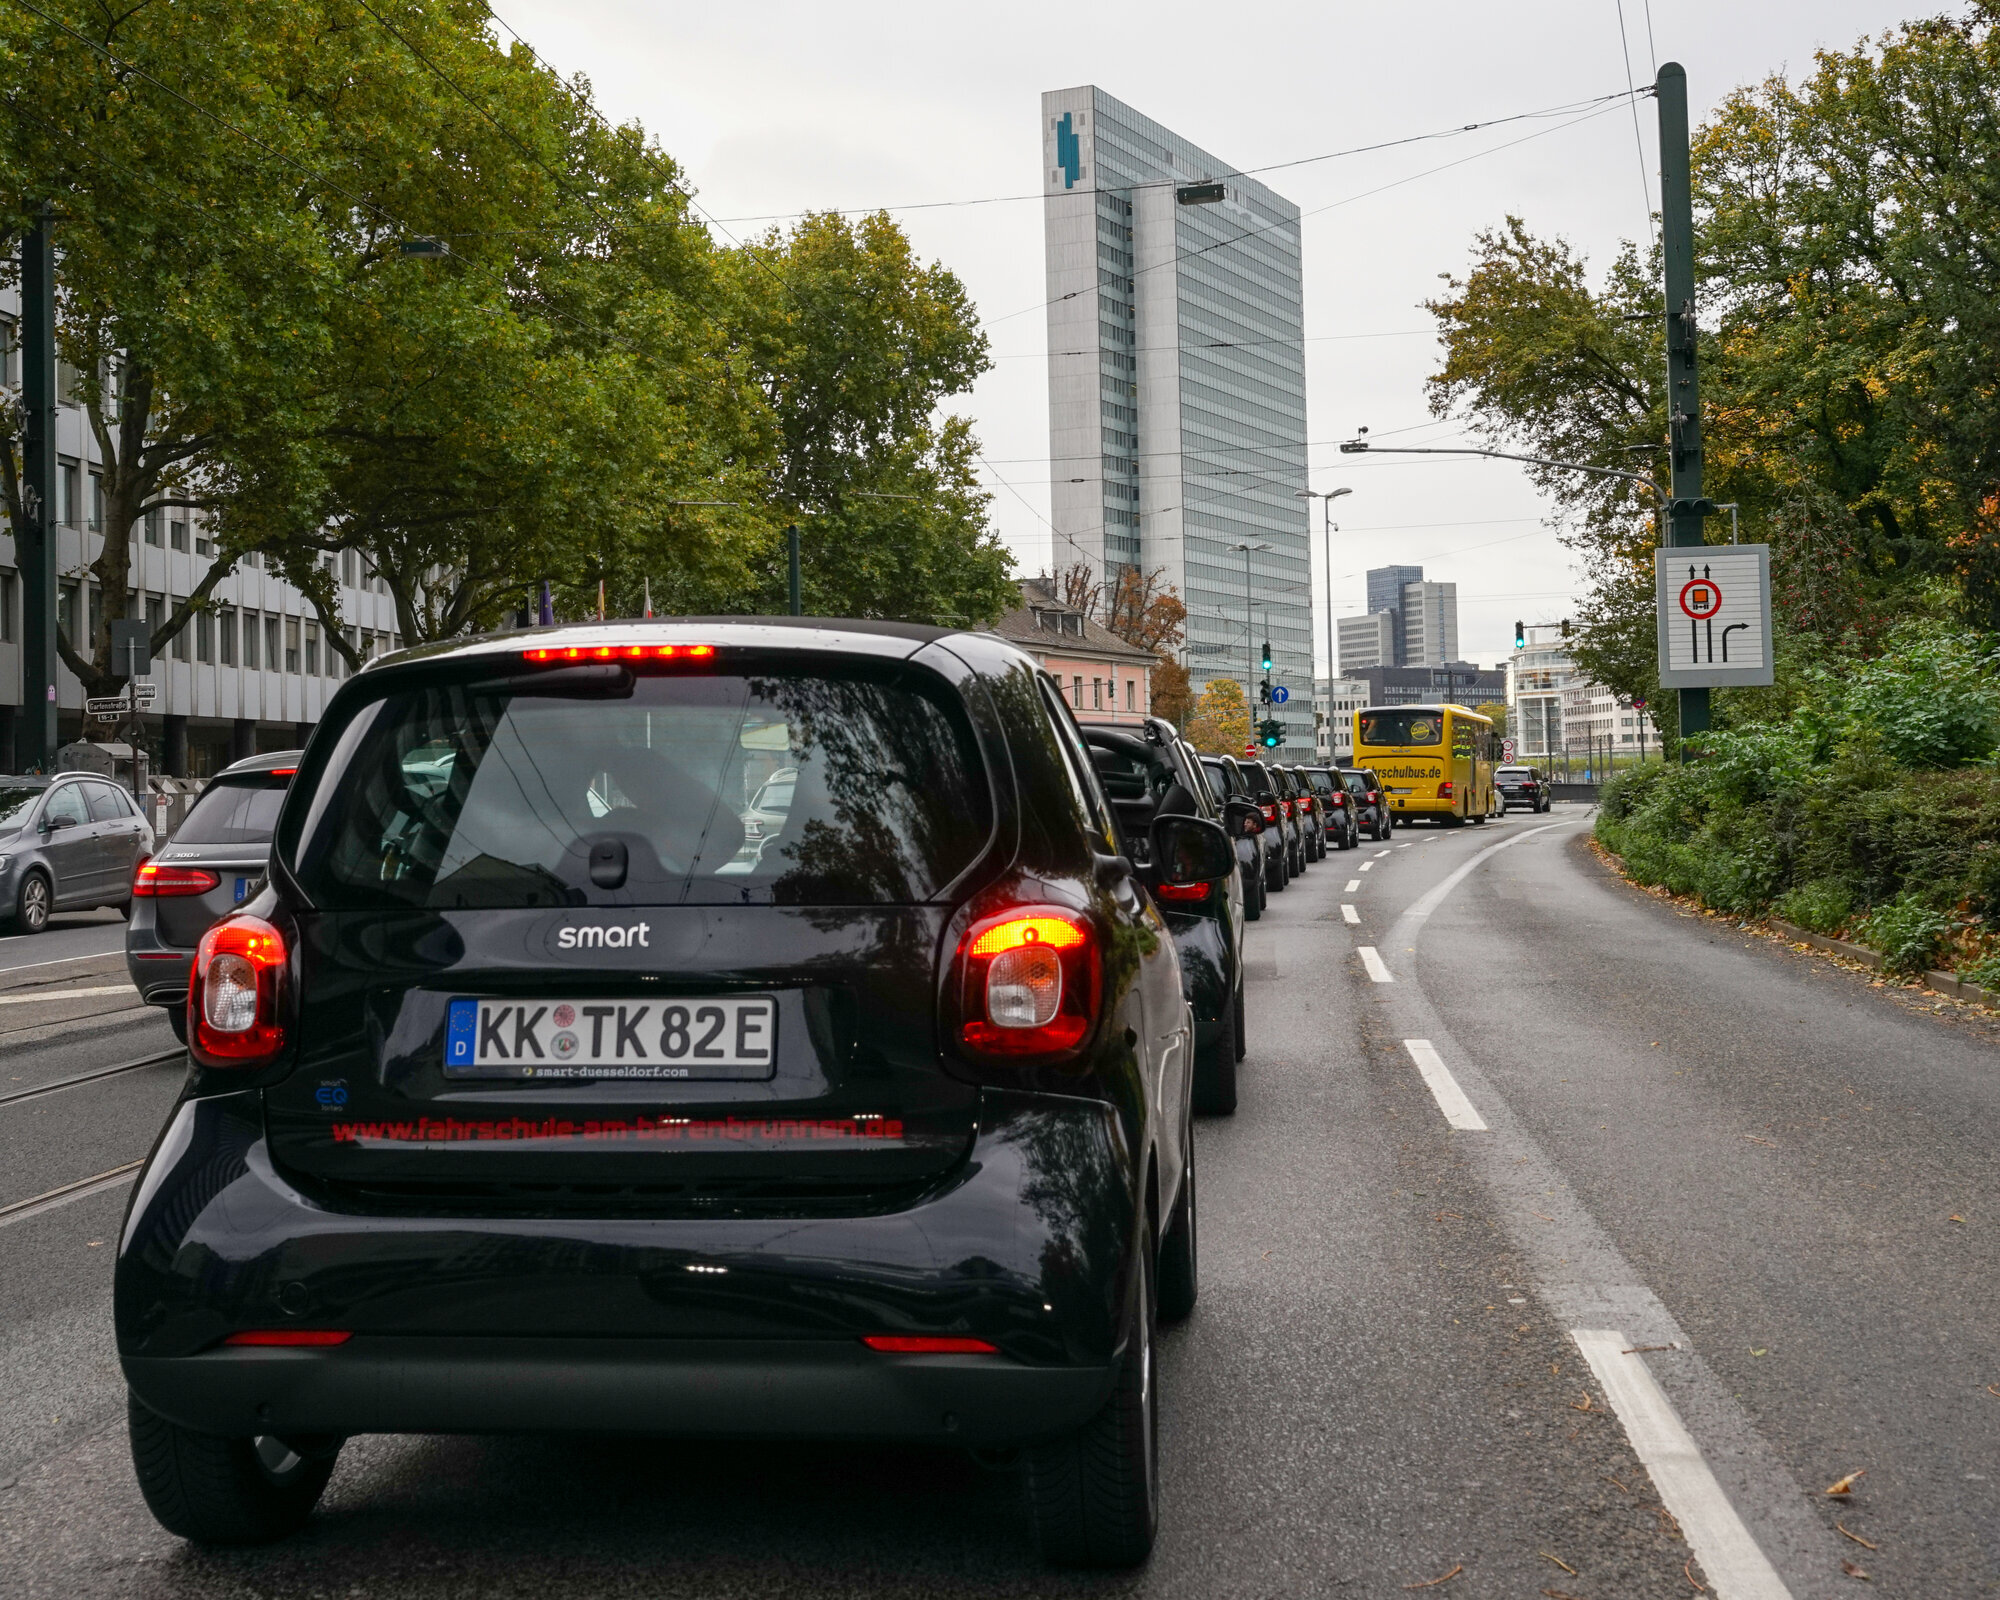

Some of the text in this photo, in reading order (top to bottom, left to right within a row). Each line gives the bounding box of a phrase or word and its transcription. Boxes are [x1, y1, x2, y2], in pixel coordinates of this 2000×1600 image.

[557, 922, 650, 949] smart
[479, 1006, 548, 1059] KK
[582, 1005, 650, 1059] TK
[454, 1041, 467, 1056] D
[536, 1065, 689, 1078] smart-duesseldorf.com
[315, 1087, 348, 1104] EQ
[332, 1115, 904, 1142] www.fahrschule-am-bärenbrunnen.de
